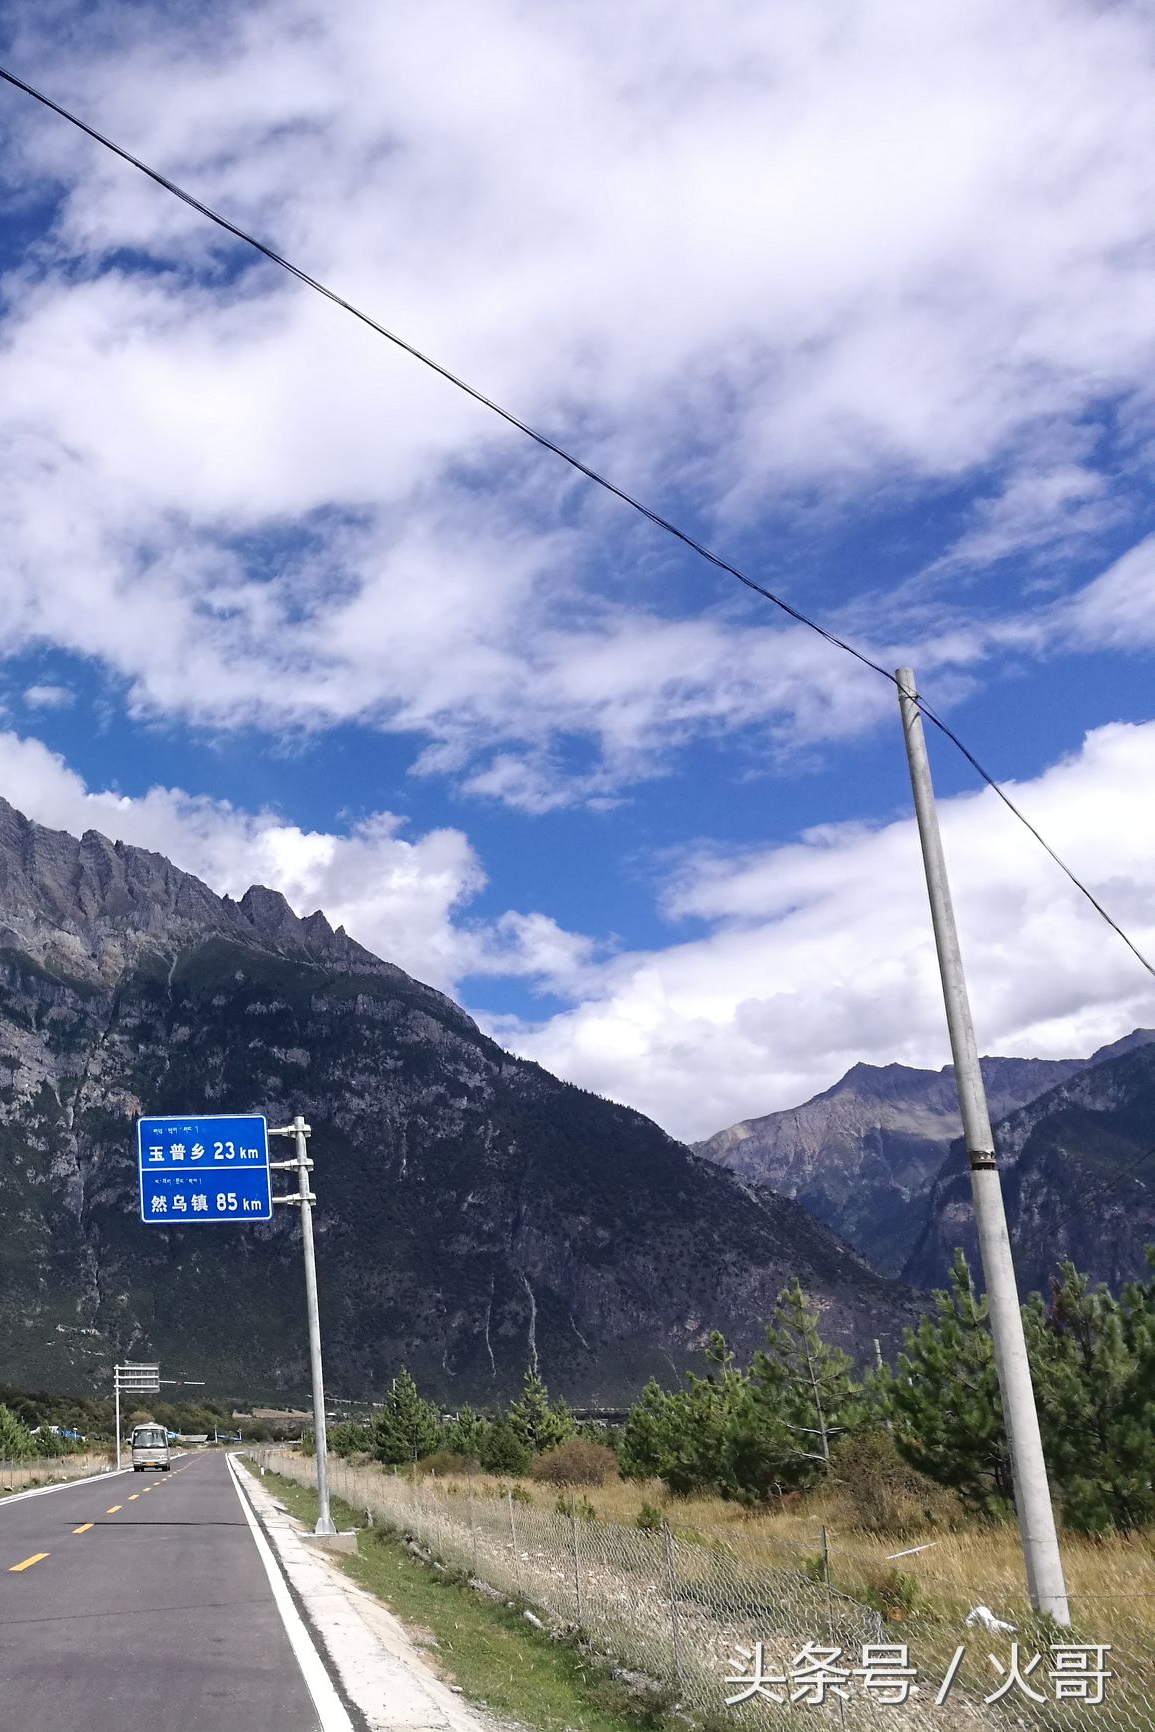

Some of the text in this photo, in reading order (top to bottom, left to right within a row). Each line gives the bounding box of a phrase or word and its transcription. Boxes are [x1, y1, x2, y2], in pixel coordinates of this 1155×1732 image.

[149, 1142, 259, 1161] 玉普乡 23 km
[151, 1193, 262, 1213] 然乌镇 85 km
